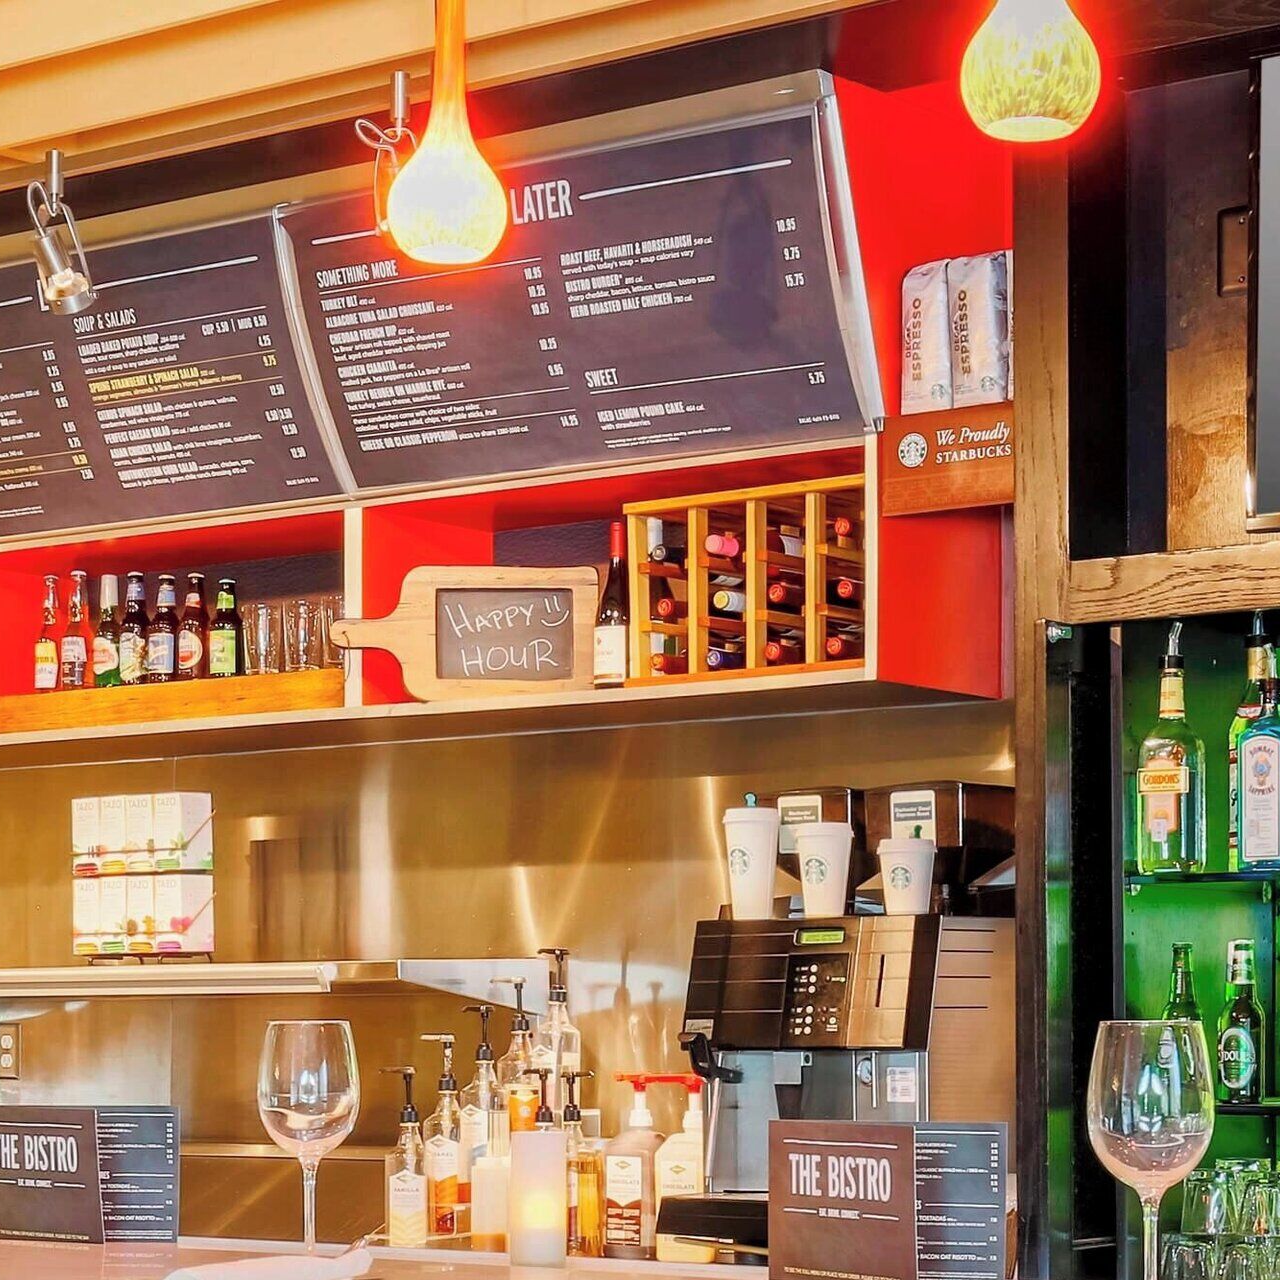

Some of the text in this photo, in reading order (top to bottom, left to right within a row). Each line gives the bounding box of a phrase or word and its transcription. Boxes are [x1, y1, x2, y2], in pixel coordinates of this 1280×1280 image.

[510, 179, 573, 225] LATER
[603, 244, 634, 259] HAVARTI
[634, 242, 641, 254] &
[641, 234, 693, 253] HORSERADISH
[316, 260, 398, 288] SOMETHING MORE
[564, 278, 591, 293] BISTRO
[785, 272, 805, 288] 15.75
[398, 300, 436, 318] CROISSANT
[589, 299, 622, 316] ROASTED
[622, 295, 641, 311] HALF
[640, 292, 673, 309] CHICKEN
[73, 308, 137, 334] SOUP & SALADS
[957, 289, 971, 375] ESPRESSO
[912, 298, 923, 382] ESPRESSO
[584, 368, 619, 388] SWEET
[808, 371, 826, 385] 5.75
[664, 401, 686, 416] CAKE
[935, 420, 1011, 447] We Proudly
[935, 444, 1012, 465] STARBUCKS
[444, 602, 535, 639] HAPPY
[460, 638, 559, 677] HOUR
[1249, 746, 1274, 757] BOMBAY
[1247, 785, 1277, 797] SAPPHIRE
[24, 1135, 79, 1174] BISTRO
[788, 1152, 892, 1203] THE BISTRO
